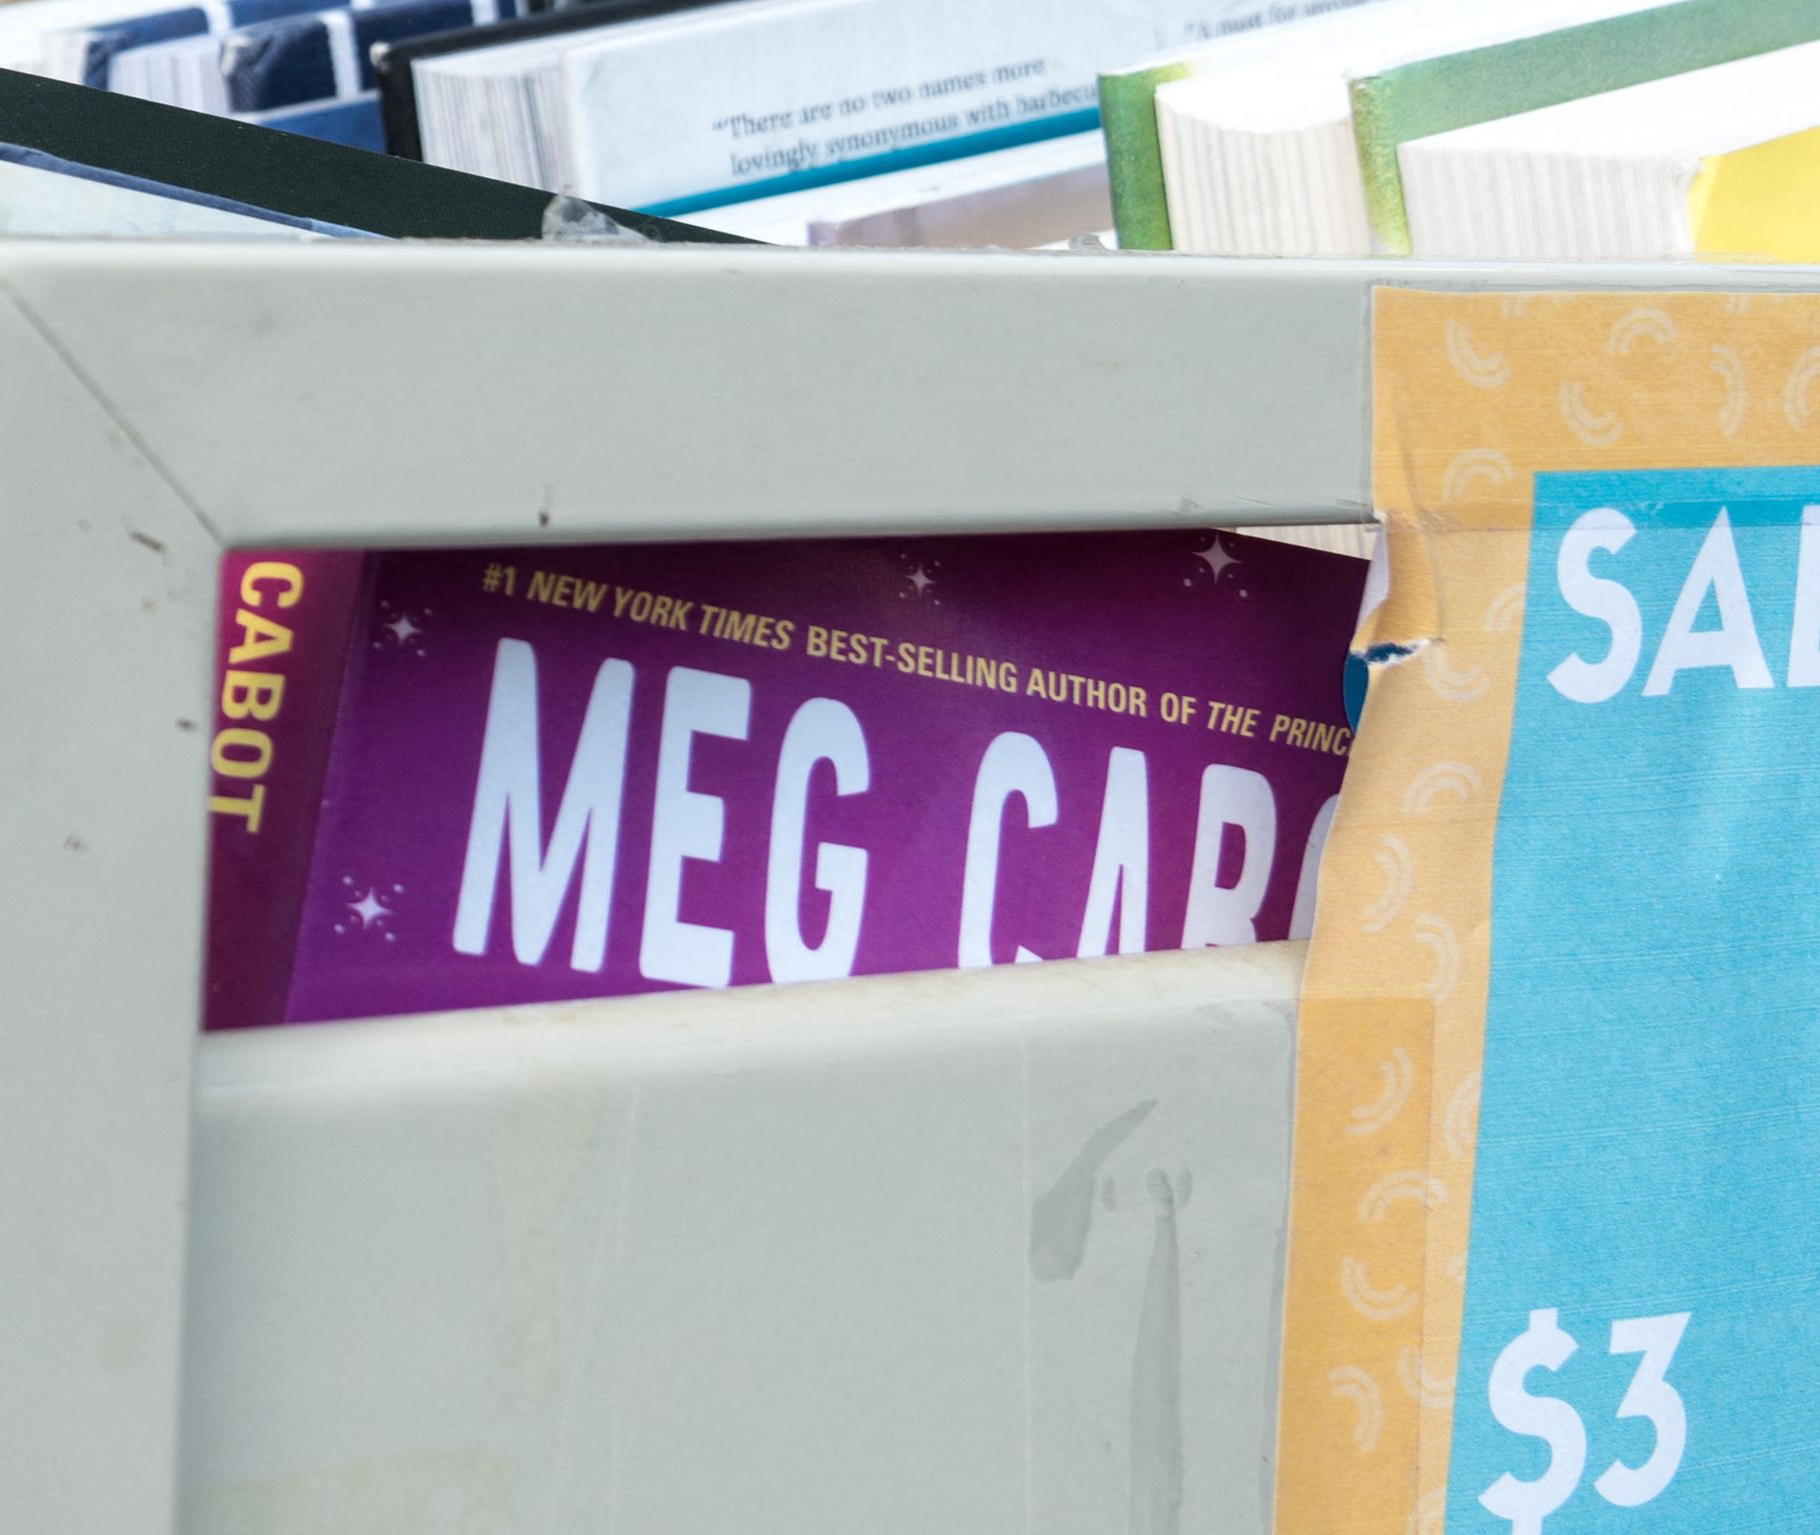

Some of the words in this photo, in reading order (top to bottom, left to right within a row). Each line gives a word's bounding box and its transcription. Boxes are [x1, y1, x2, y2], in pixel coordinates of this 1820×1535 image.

[729, 141, 818, 177] lovingly
[823, 114, 961, 162] synonymous
[964, 97, 1012, 127] with
[799, 101, 833, 126] are
[837, 96, 867, 119] no
[871, 85, 912, 112] two
[917, 72, 986, 102] names
[990, 57, 1046, 84] more
[207, 560, 305, 833] CABOT
[481, 565, 517, 597] #1
[526, 571, 609, 612] NEW
[611, 588, 689, 631] YORK
[699, 604, 795, 651] TIMES
[806, 625, 1019, 693] BEST-SELLING
[1025, 668, 1149, 719] AUTHOR
[1161, 691, 1198, 725] OF
[1207, 701, 1261, 738] THE
[1269, 714, 1357, 757] PRINC
[451, 636, 871, 989] MEG
[1476, 1308, 1693, 1535] $3
